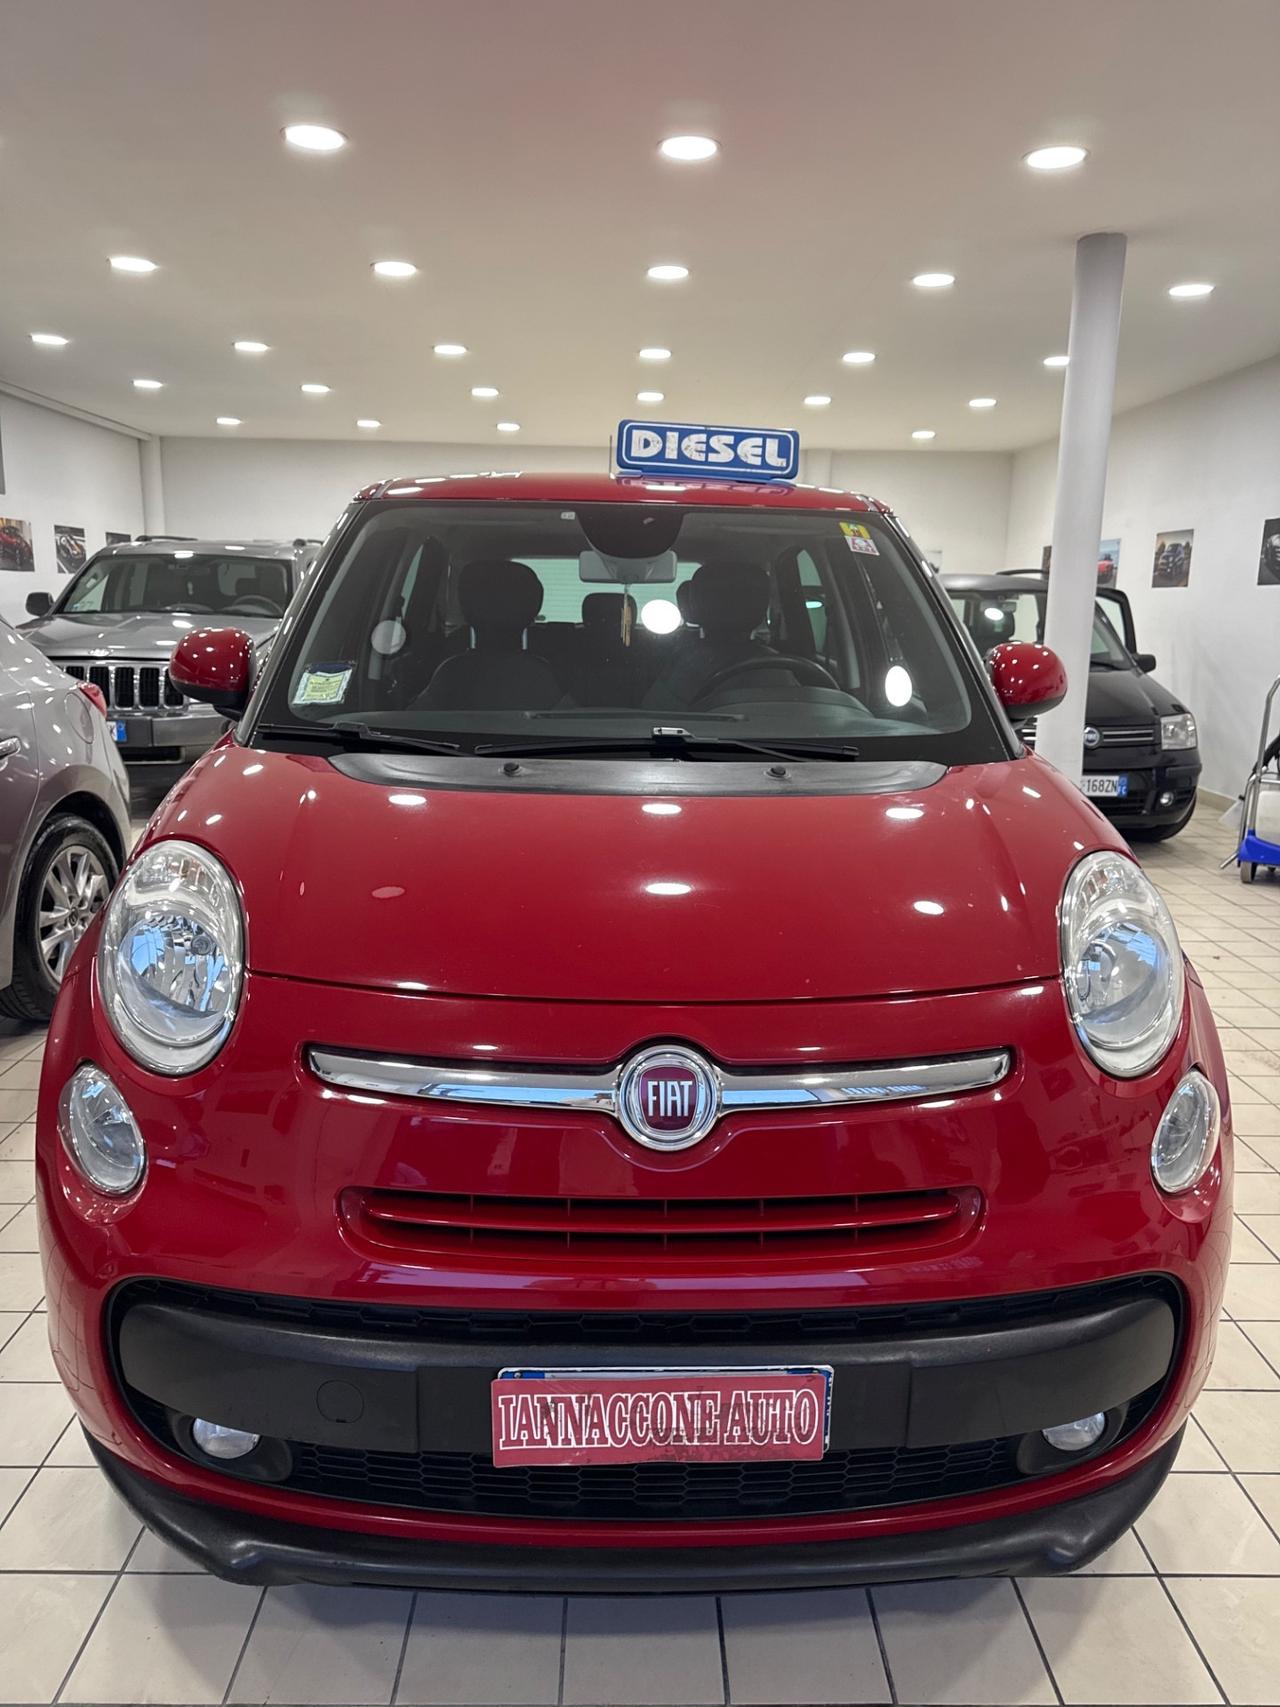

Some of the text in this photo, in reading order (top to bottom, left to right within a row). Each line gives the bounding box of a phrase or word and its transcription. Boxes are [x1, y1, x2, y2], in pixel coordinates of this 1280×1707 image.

[630, 429, 787, 467] DIESEL
[647, 1080, 693, 1117] FIAT
[498, 1388, 819, 1450] IANNACCONE AUTO
